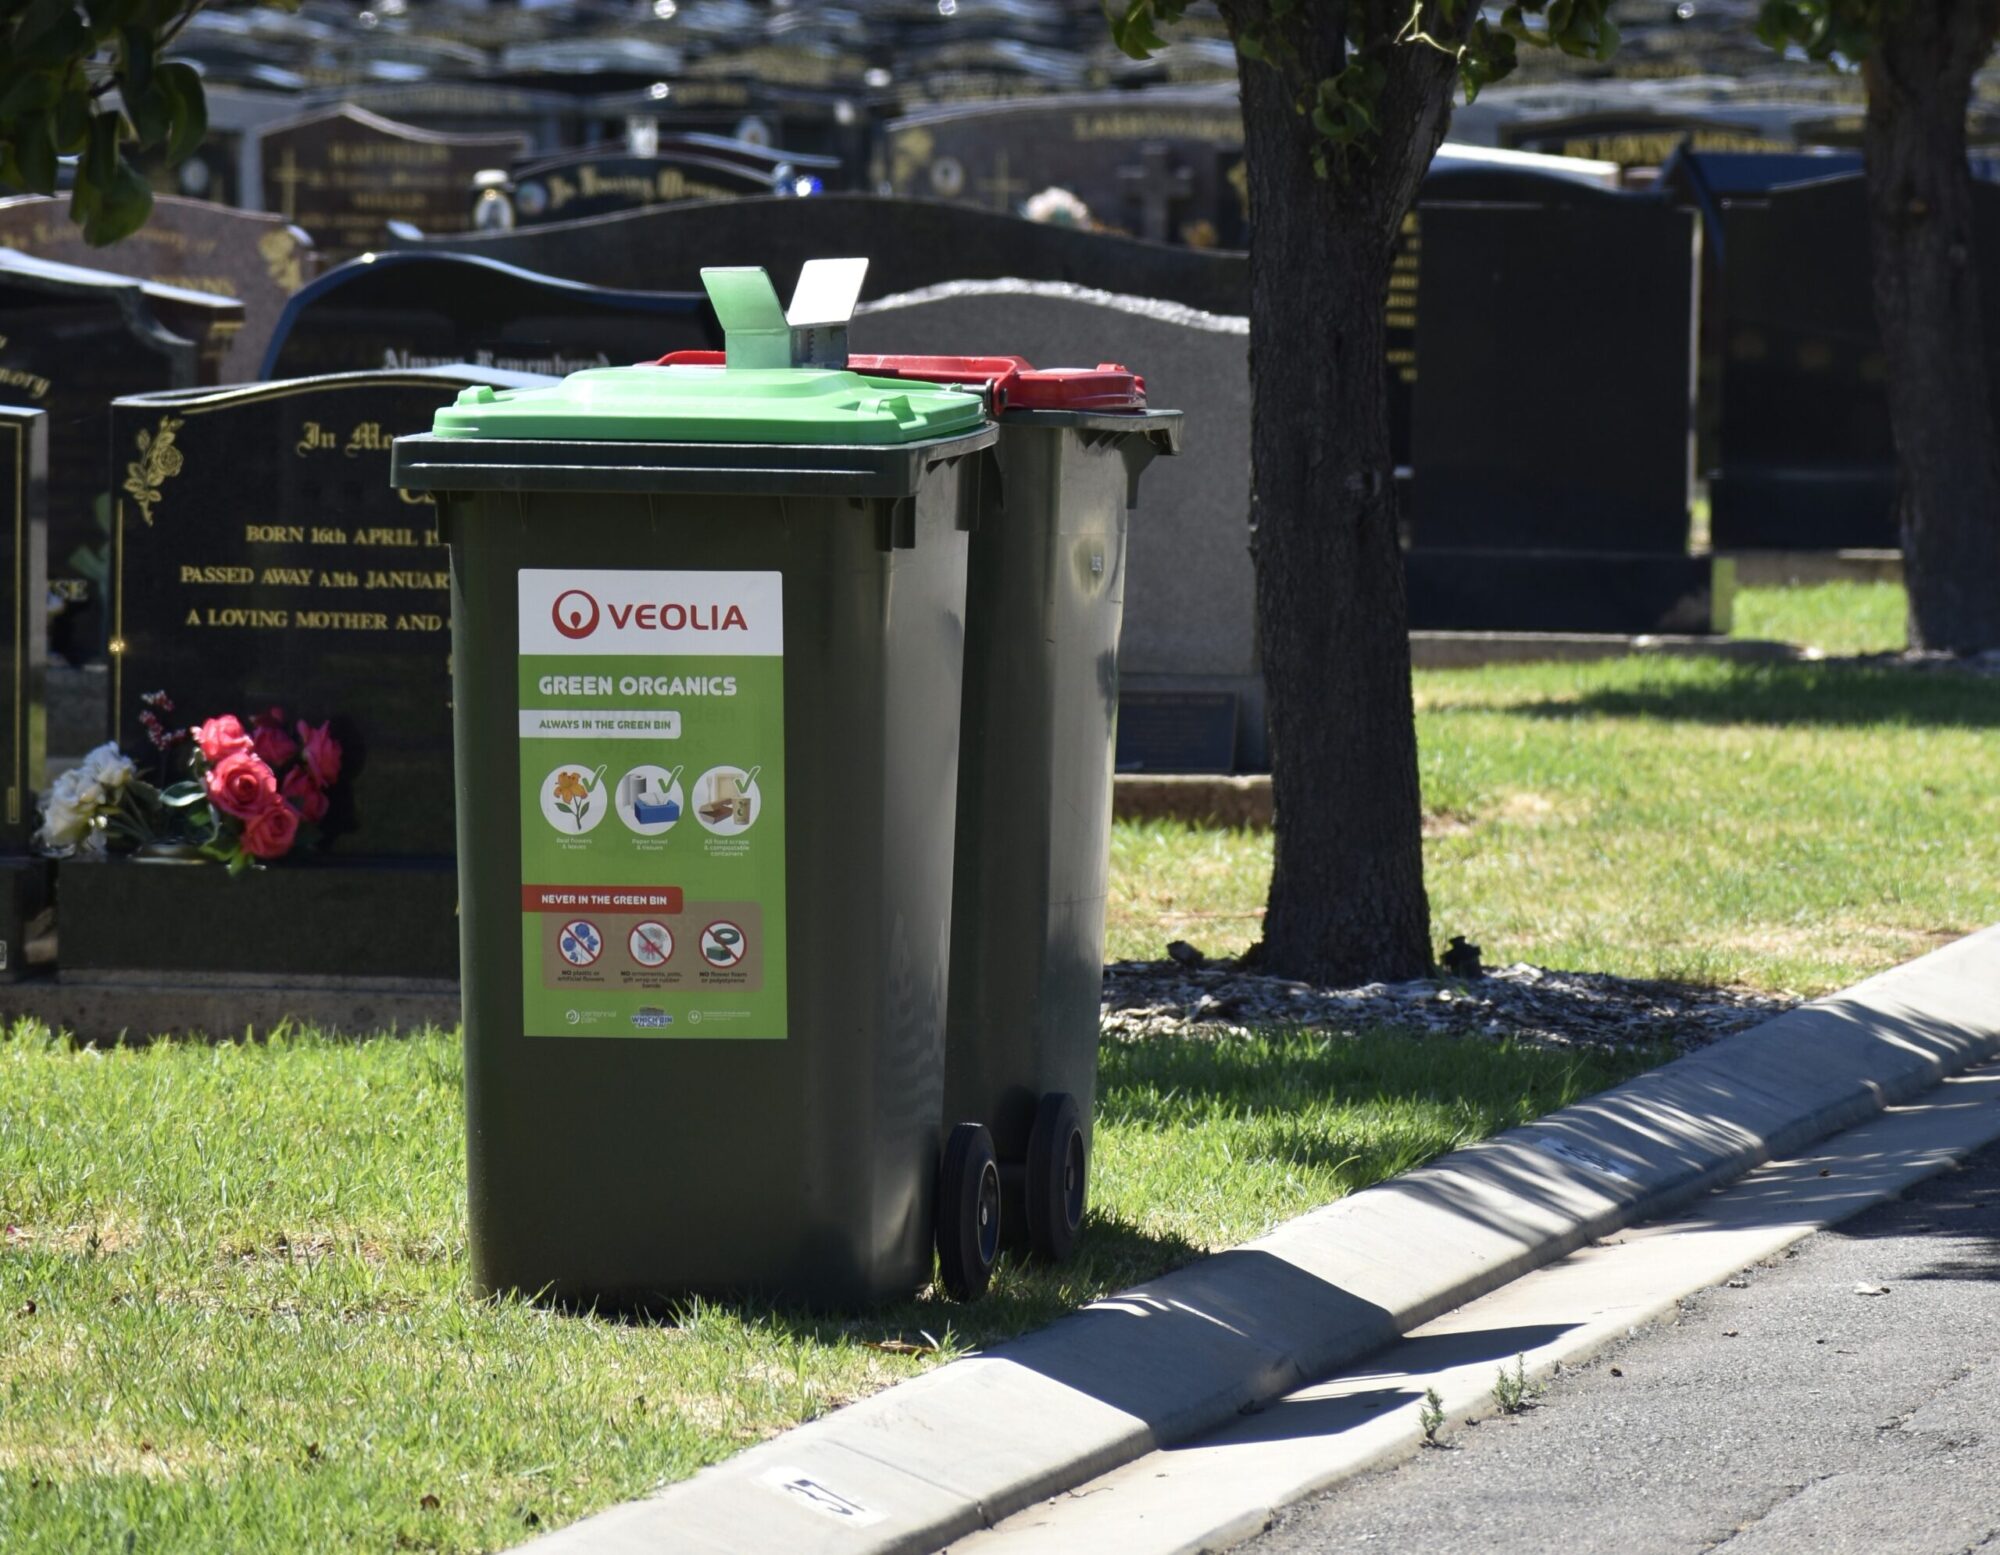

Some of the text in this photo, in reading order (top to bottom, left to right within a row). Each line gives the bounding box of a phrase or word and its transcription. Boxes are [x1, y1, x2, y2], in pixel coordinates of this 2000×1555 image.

[245, 525, 304, 543] BORN
[353, 528, 418, 546] APRIL
[180, 566, 254, 584] PASSED
[261, 568, 314, 586] AWAY
[365, 571, 450, 590] JANUAR
[186, 609, 200, 626] A
[209, 609, 287, 628] LOVING
[296, 611, 388, 630] MOTHER
[396, 613, 441, 631] AND
[607, 603, 748, 631] VEOLIA
[538, 675, 737, 696] GREEN ORGANICS
[539, 720, 671, 731] ALWAYS IN THE GREEN BIN
[541, 895, 667, 905] NEVER IN THE GREEN BIN
[631, 1016, 658, 1024] WHICH
